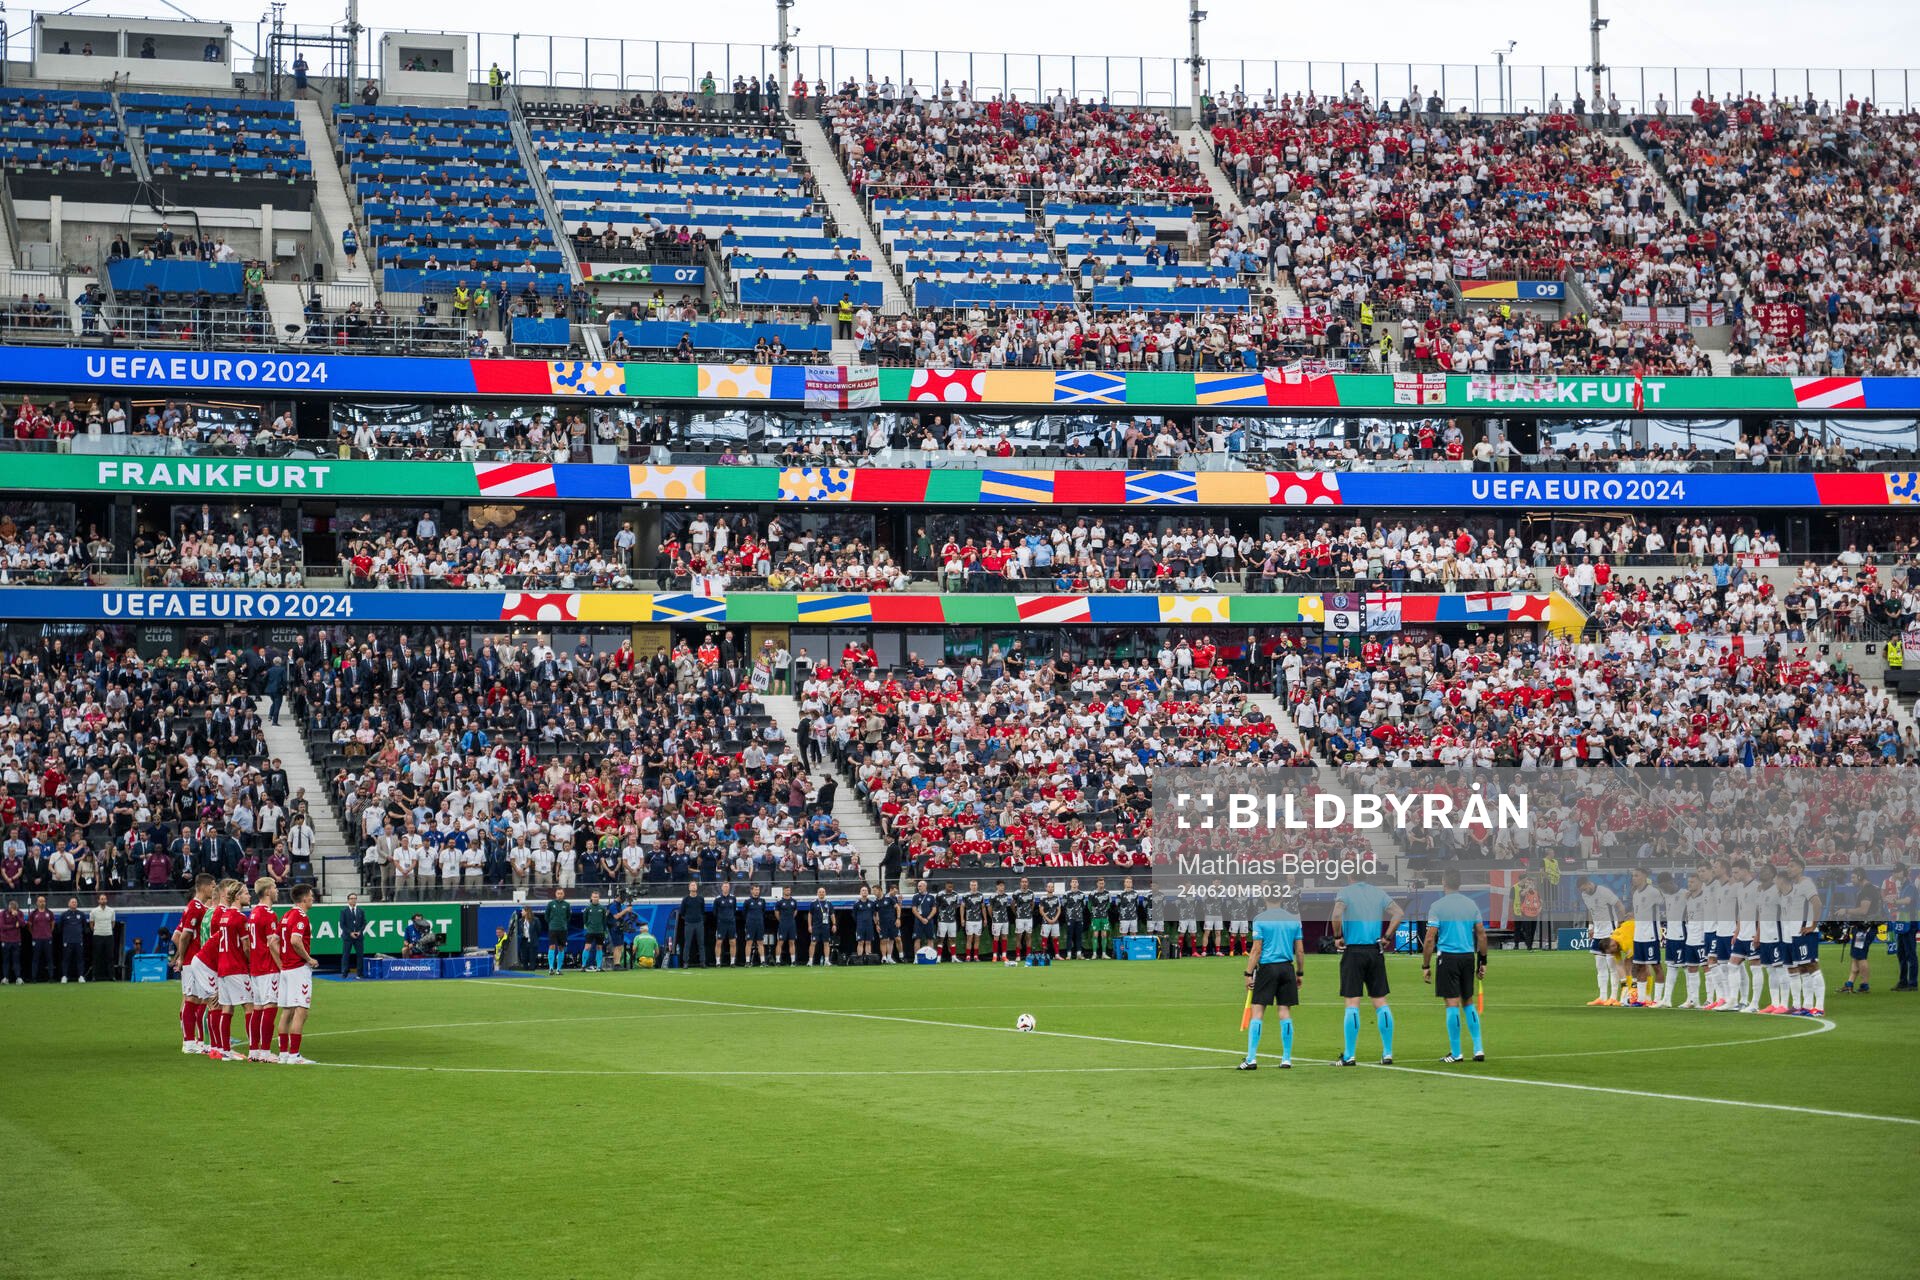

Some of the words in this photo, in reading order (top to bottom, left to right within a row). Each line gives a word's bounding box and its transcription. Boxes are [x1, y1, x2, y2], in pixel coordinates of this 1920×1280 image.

[675, 269, 697, 281] 07
[1536, 284, 1558, 296] 09
[99, 461, 331, 489] FRANKFURT
[145, 634, 173, 643] CLUB
[271, 634, 299, 643] CLUB
[218, 926, 229, 952] 21
[281, 927, 287, 954] 5
[1570, 939, 1594, 949] QAT
[1711, 940, 1717, 949] 5
[1647, 946, 1654, 957] 8
[1676, 949, 1683, 960] 7
[1697, 948, 1706, 959] 12
[1773, 947, 1780, 958] 6
[1799, 945, 1808, 957] 10
